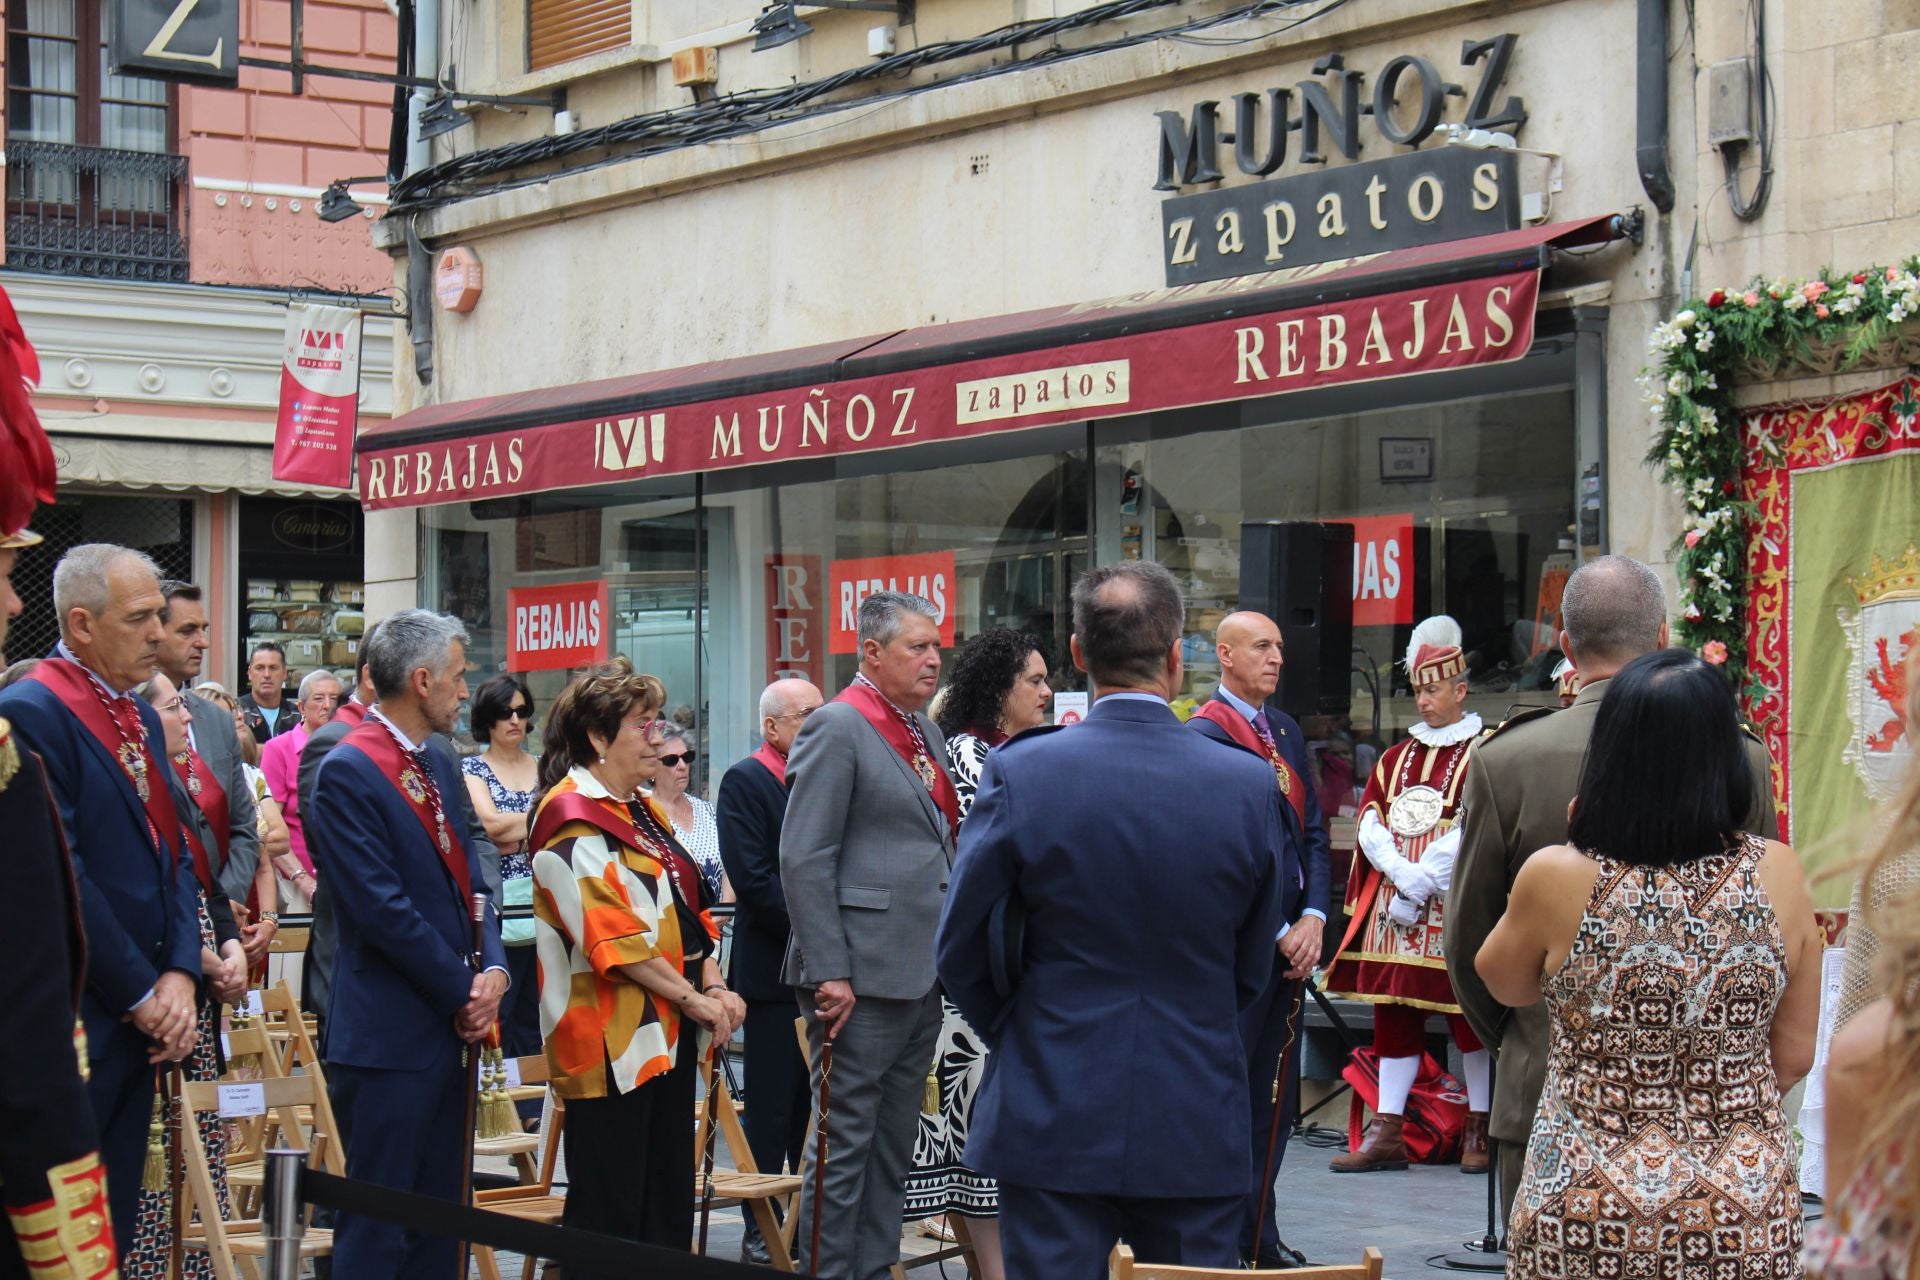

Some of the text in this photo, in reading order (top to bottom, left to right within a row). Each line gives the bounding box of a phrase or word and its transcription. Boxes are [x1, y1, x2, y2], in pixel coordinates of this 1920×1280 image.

[1152, 33, 1528, 191] MUÑOZ
[1168, 163, 1499, 263] zapatos
[368, 437, 524, 501] REBAJAS
[709, 387, 917, 460] MUÑOZ
[968, 370, 1117, 413] zapatos
[1234, 286, 1514, 383] REBAJAS
[516, 599, 600, 652] REBAJAS
[771, 565, 814, 681] RE
